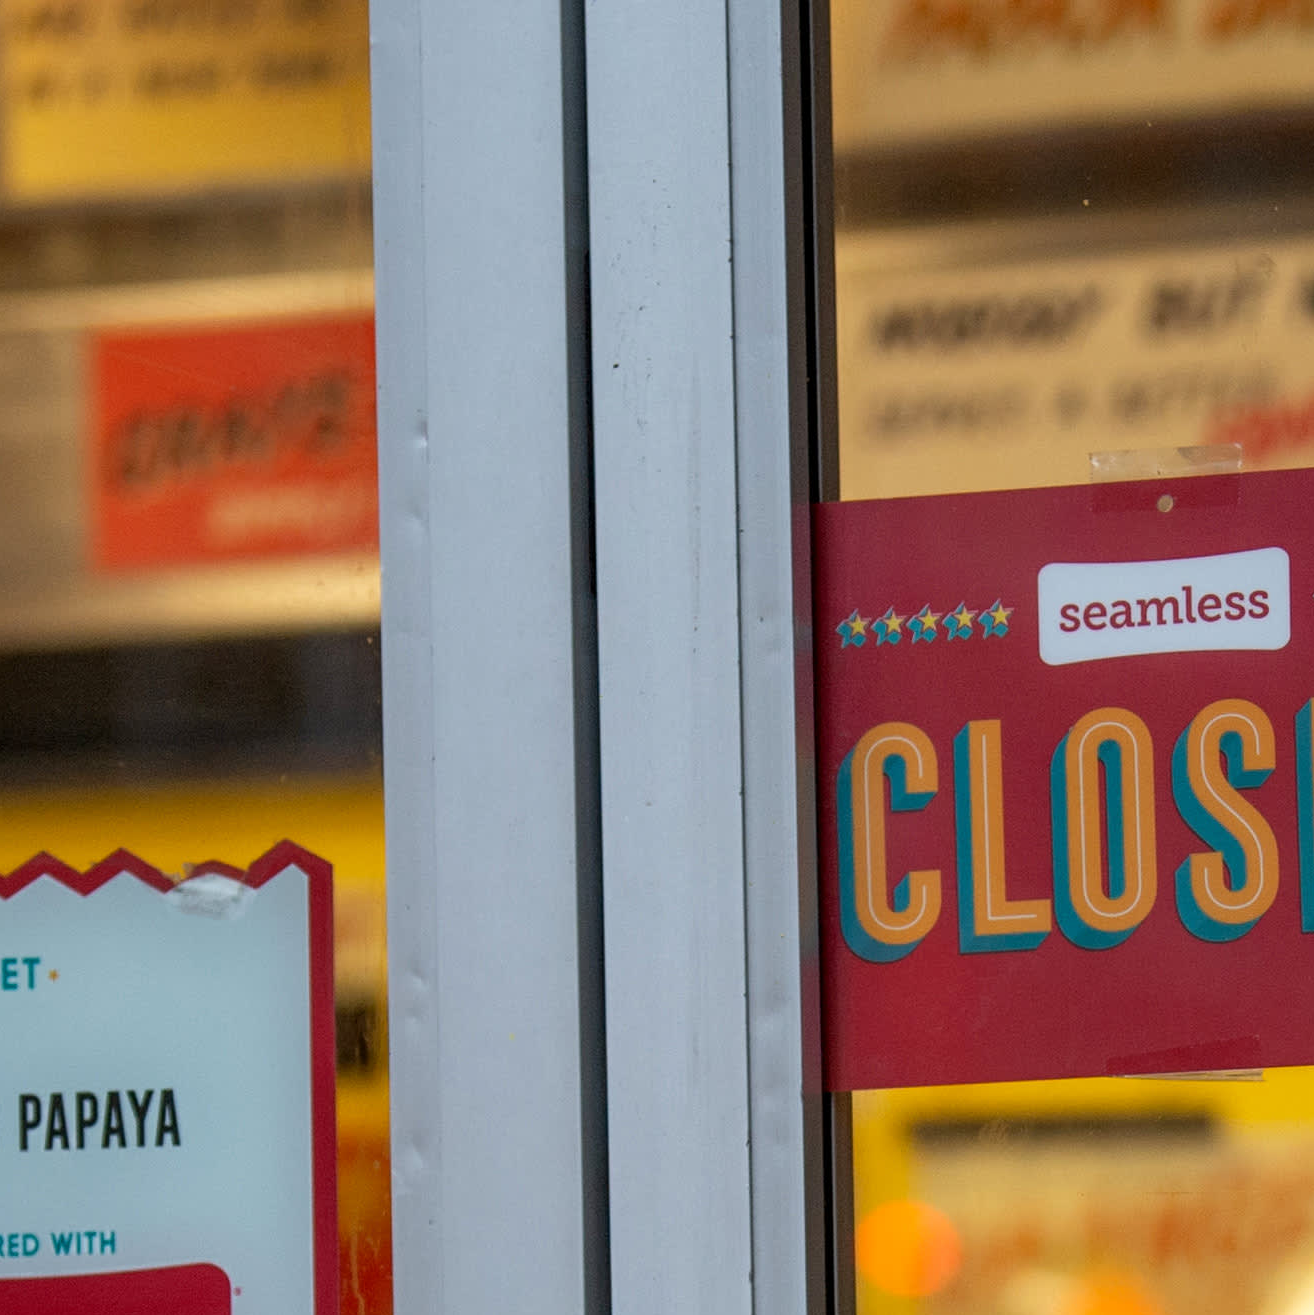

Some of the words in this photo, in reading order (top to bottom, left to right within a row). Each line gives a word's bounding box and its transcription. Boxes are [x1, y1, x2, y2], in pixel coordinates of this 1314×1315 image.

[1058, 584, 1271, 634] seamless
[19, 1089, 180, 1151] PAPAYA
[51, 1231, 115, 1255] WITH
